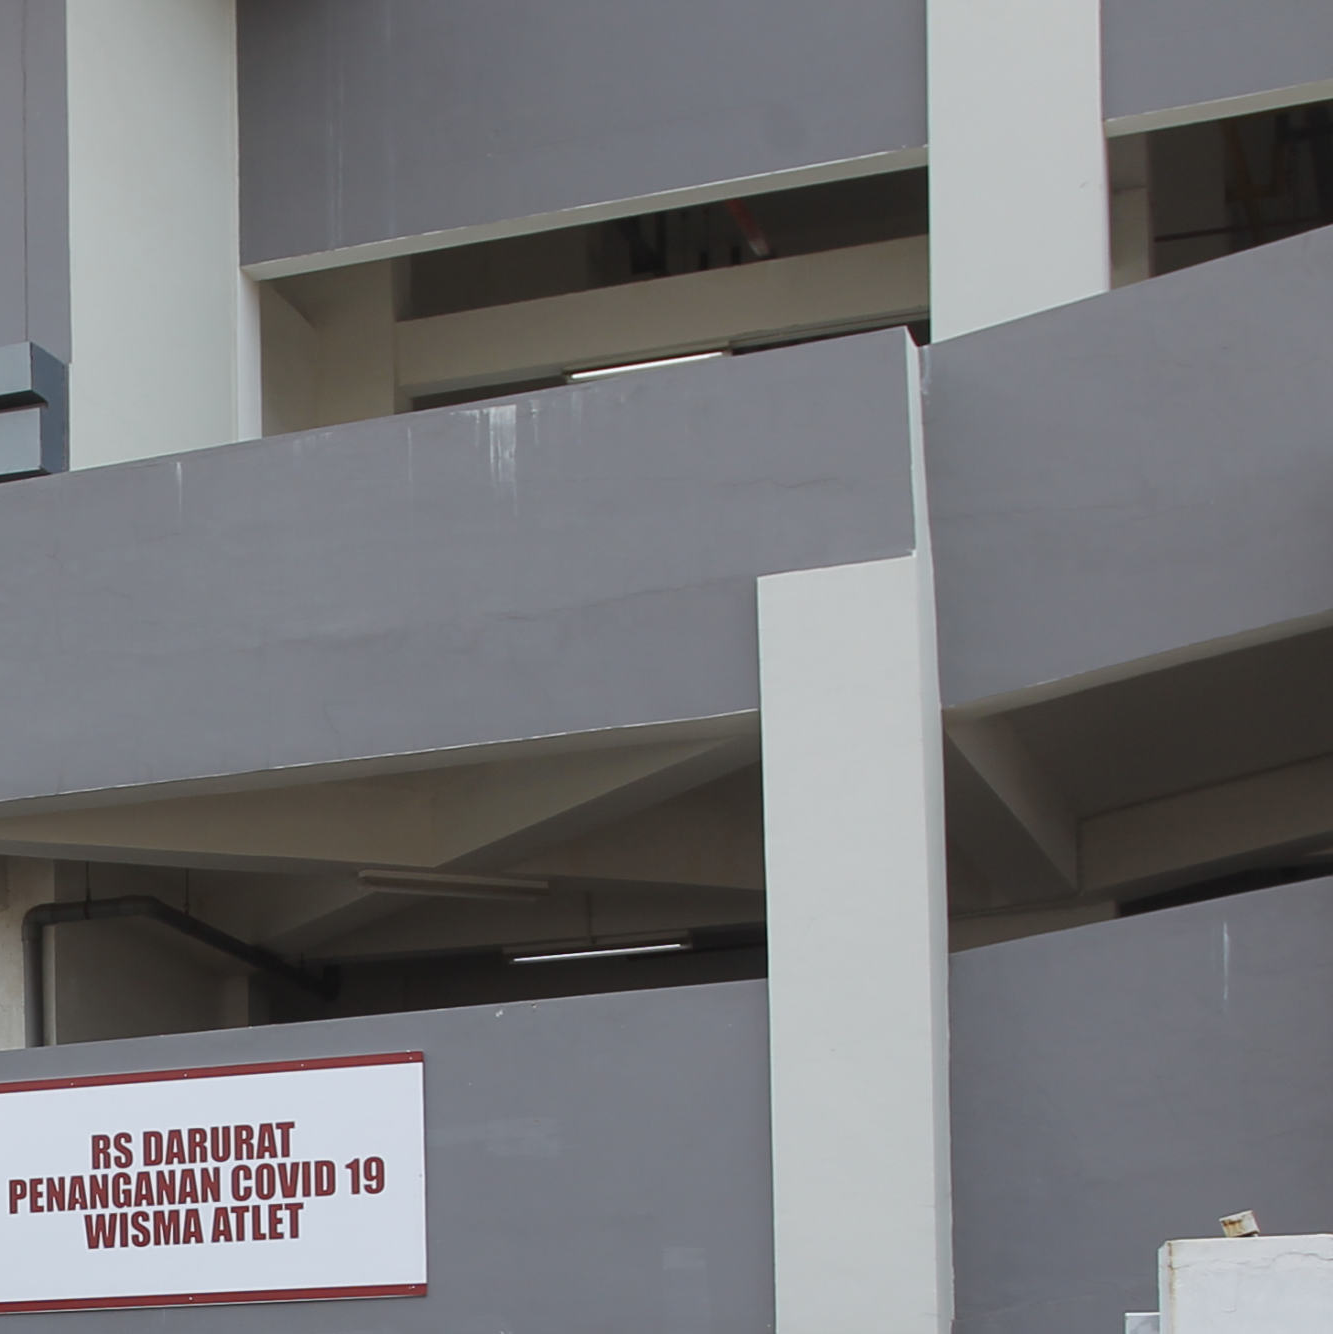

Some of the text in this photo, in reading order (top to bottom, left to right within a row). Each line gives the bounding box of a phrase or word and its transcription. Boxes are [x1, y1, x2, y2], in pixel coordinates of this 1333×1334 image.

[91, 1121, 296, 1170] RS DARURAT
[8, 1156, 386, 1215] PENANGANAN COVID 19
[84, 1202, 304, 1250] WISMA ATLET
